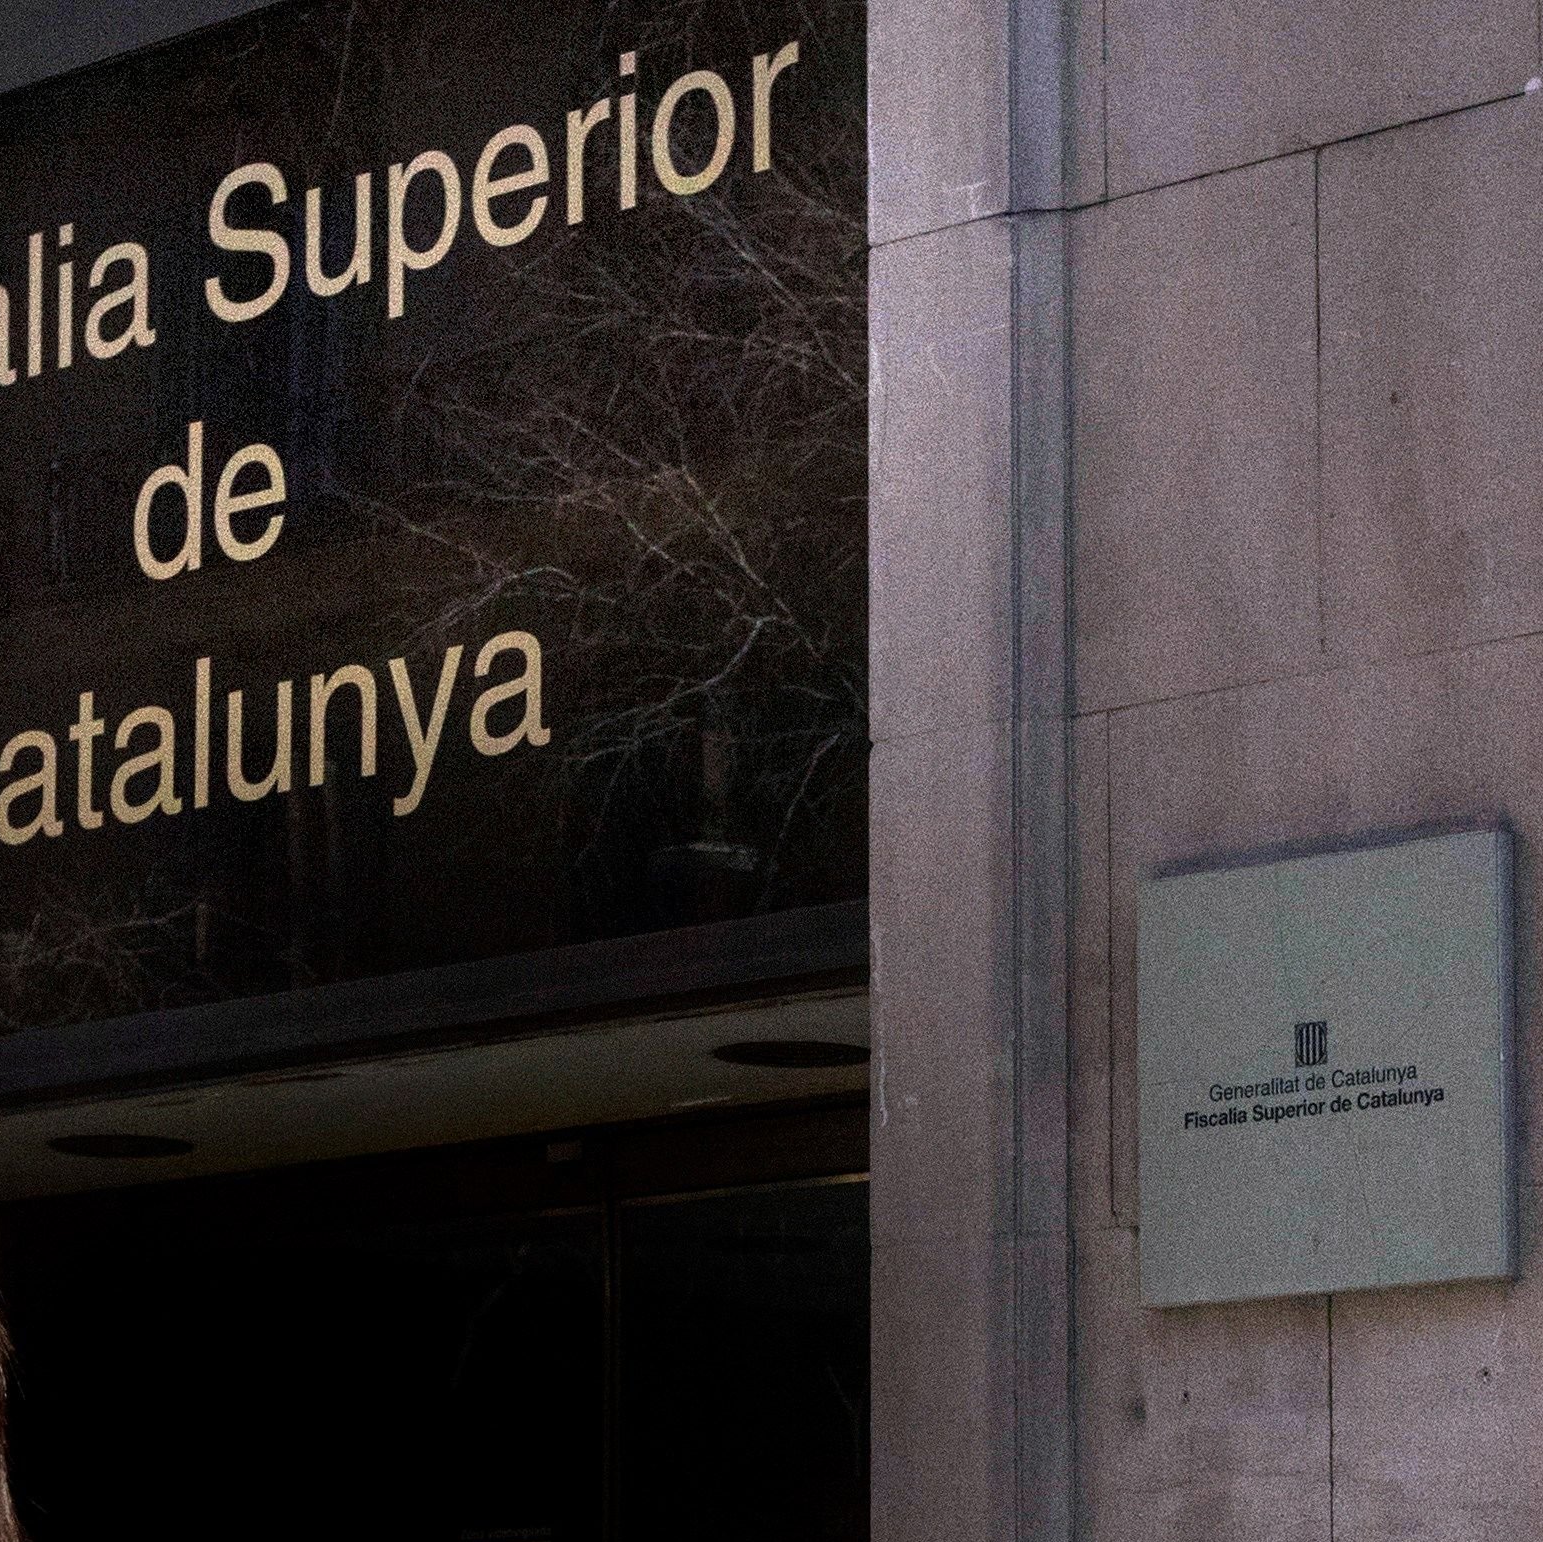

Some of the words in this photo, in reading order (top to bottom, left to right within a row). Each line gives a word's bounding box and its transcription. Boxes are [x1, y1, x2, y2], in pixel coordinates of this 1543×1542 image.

[204, 40, 801, 325] Superior
[132, 420, 288, 582] de
[1183, 1109, 1248, 1130] Fiscalia
[1252, 1099, 1326, 1125] Superior
[1330, 1096, 1352, 1114] de
[1358, 1086, 1445, 1111] Catalunya
[1208, 1073, 1300, 1103] Generalitat
[1305, 1072, 1326, 1092] de
[1331, 1064, 1418, 1089] Catalunya
